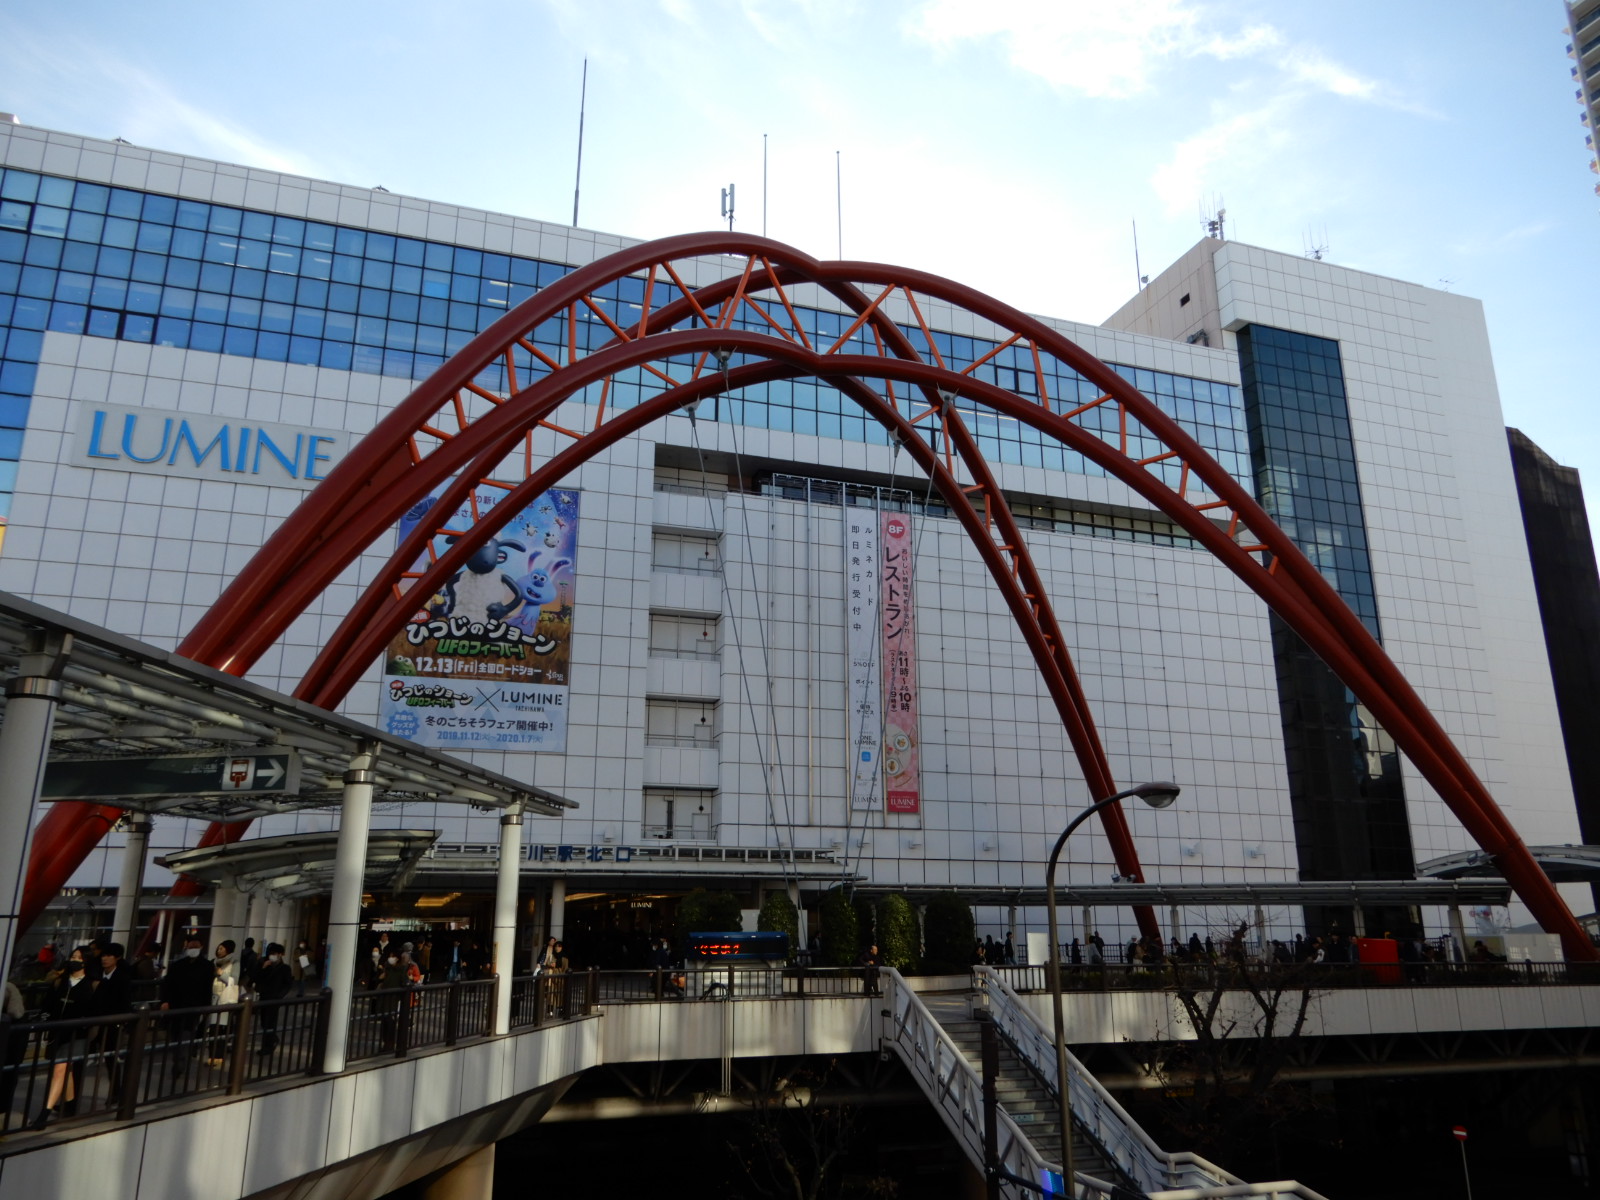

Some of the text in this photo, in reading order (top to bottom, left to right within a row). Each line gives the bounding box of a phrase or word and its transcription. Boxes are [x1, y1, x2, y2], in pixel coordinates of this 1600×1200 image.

[87, 410, 336, 480] LUMINE
[888, 525, 904, 534] 8F
[865, 527, 874, 606] ルミネカード
[851, 525, 862, 631] 即日発行受付中
[885, 546, 903, 640] レストラン
[406, 616, 556, 654] ひつじのショーン
[437, 638, 526, 659] UFOフィーバー!
[391, 684, 473, 705] ひつじのショーン
[501, 690, 563, 706] LUMINE
[425, 715, 554, 732] 冬のごちそうフェア開催中!
[890, 798, 916, 806] LUMINE
[497, 845, 631, 862] 川駅北口
